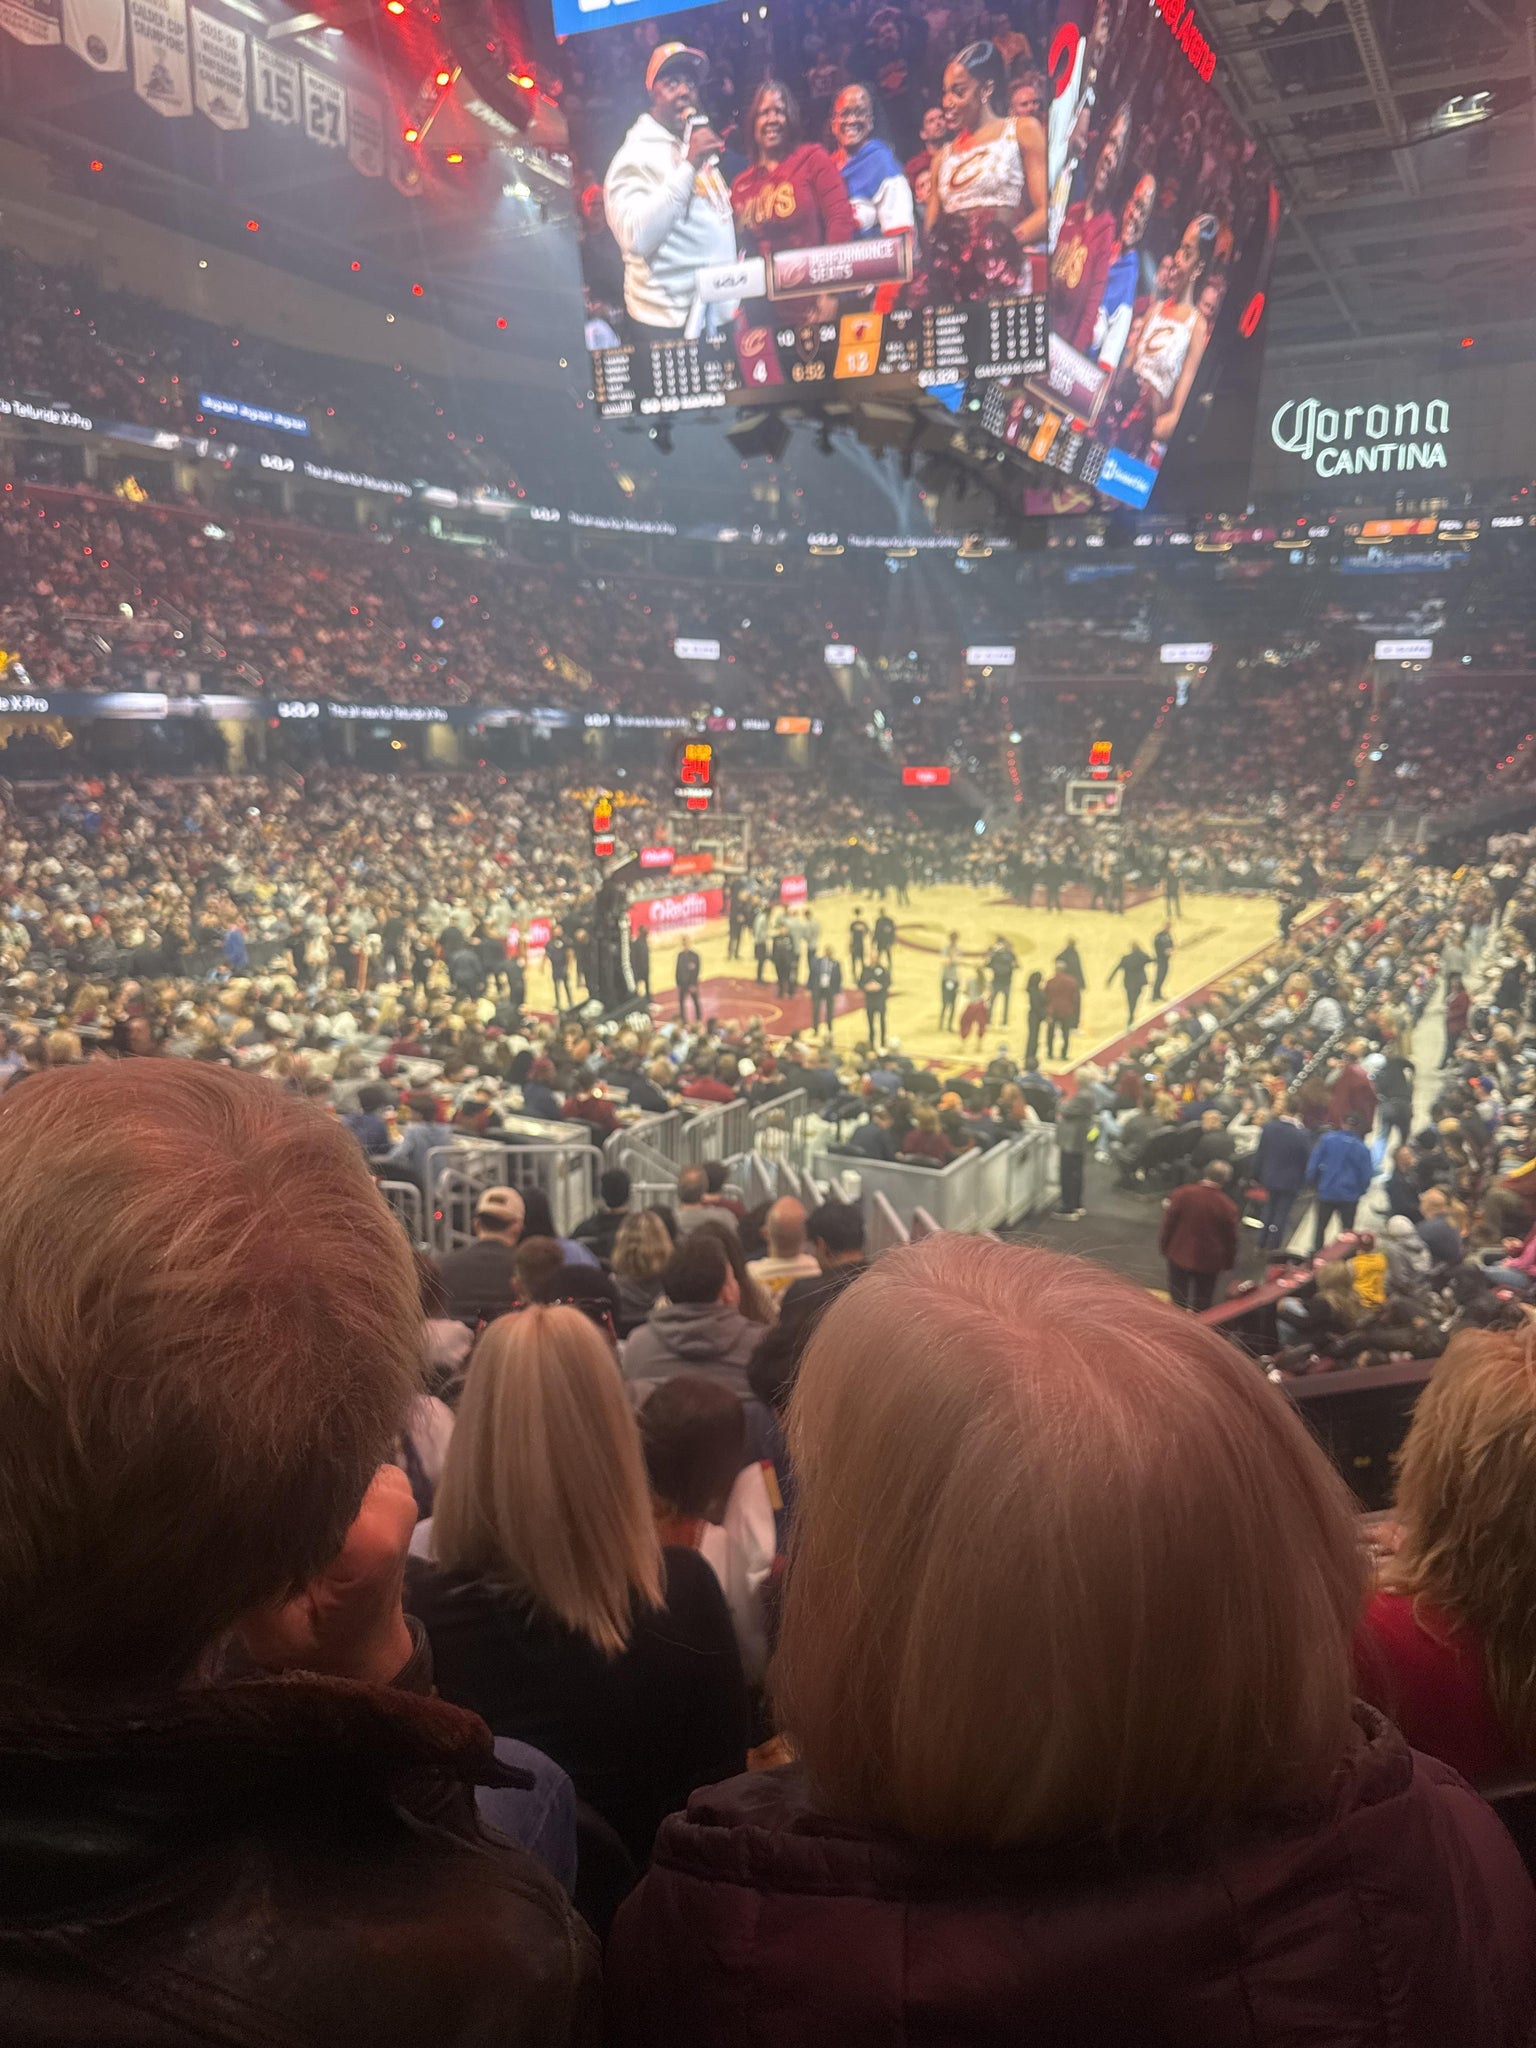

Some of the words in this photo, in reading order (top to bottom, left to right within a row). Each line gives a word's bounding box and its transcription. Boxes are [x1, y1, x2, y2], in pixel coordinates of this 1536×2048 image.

[263, 69, 294, 119] 15
[310, 93, 340, 141] 27
[809, 263, 854, 285] SEATS
[1271, 398, 1450, 460] Corona
[1315, 442, 1447, 478] CANTINA
